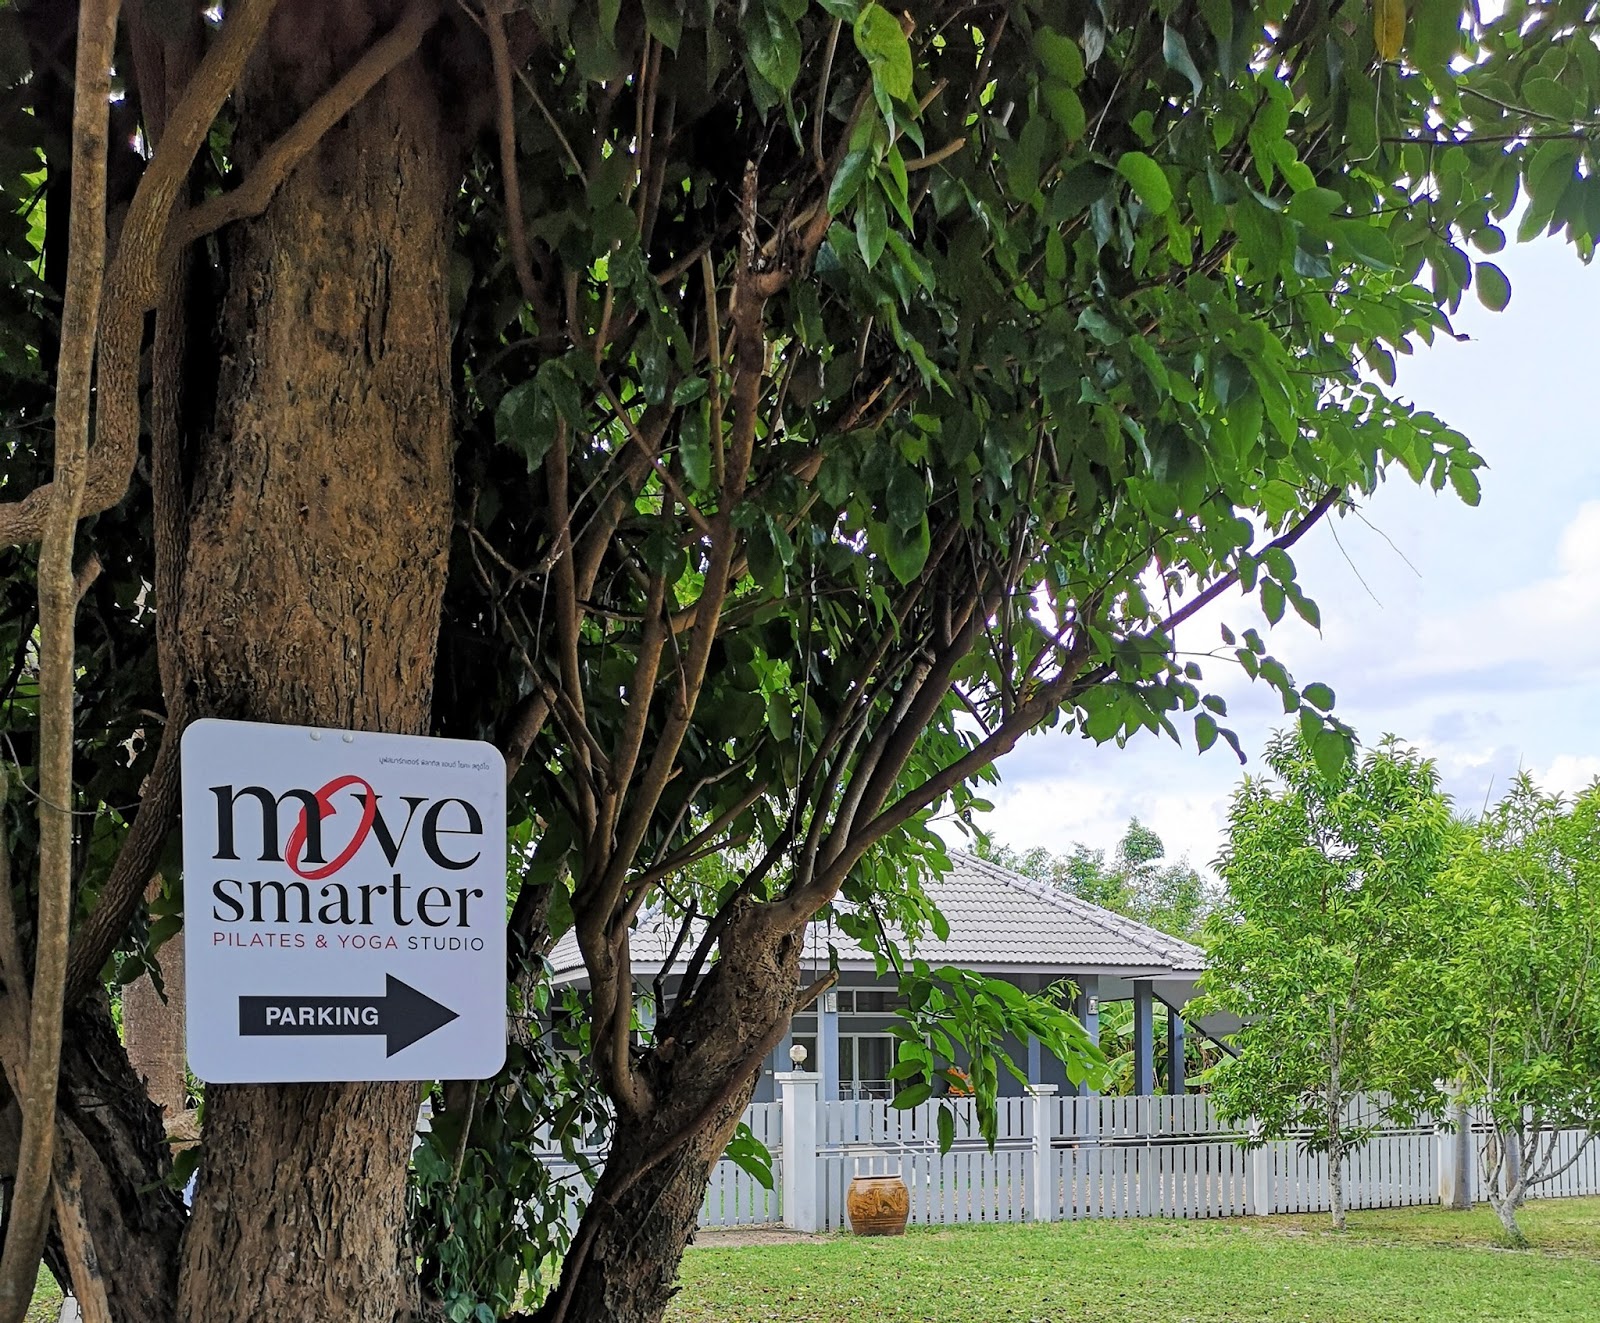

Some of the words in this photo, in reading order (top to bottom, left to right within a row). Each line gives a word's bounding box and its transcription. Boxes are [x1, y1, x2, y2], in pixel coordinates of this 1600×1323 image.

[209, 774, 483, 880] move
[212, 872, 484, 928] smarter
[213, 932, 306, 949] PILATES
[315, 934, 328, 949] &
[338, 935, 398, 950] YOGA
[407, 936, 484, 952] STUDIO
[265, 1006, 380, 1027] PARKING
